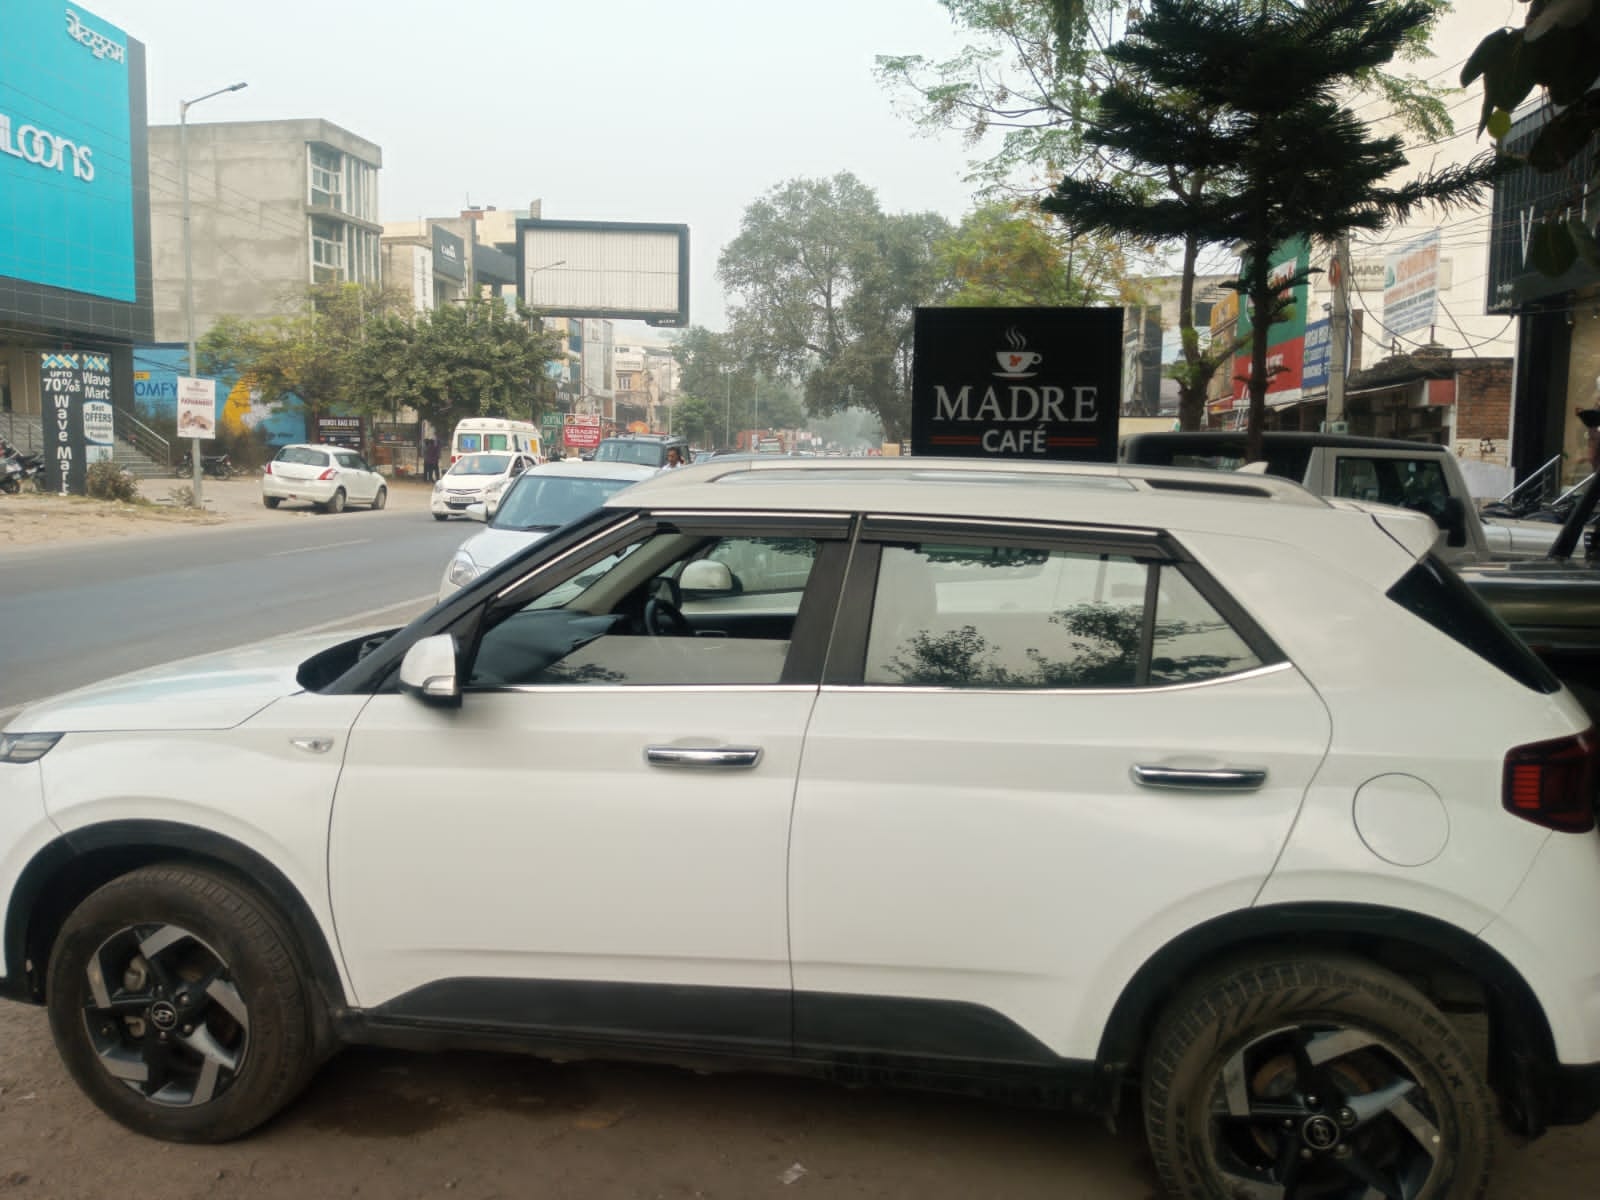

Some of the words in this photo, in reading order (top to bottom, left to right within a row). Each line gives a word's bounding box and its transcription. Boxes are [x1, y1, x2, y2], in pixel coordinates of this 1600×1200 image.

[82, 371, 111, 386] Wave
[84, 386, 110, 400] Mart
[54, 394, 69, 441] Wave
[85, 412, 112, 424] OFFERS
[932, 385, 1099, 422] MADRE
[982, 424, 1046, 454] CAFÉ
[57, 445, 72, 496] Mart
